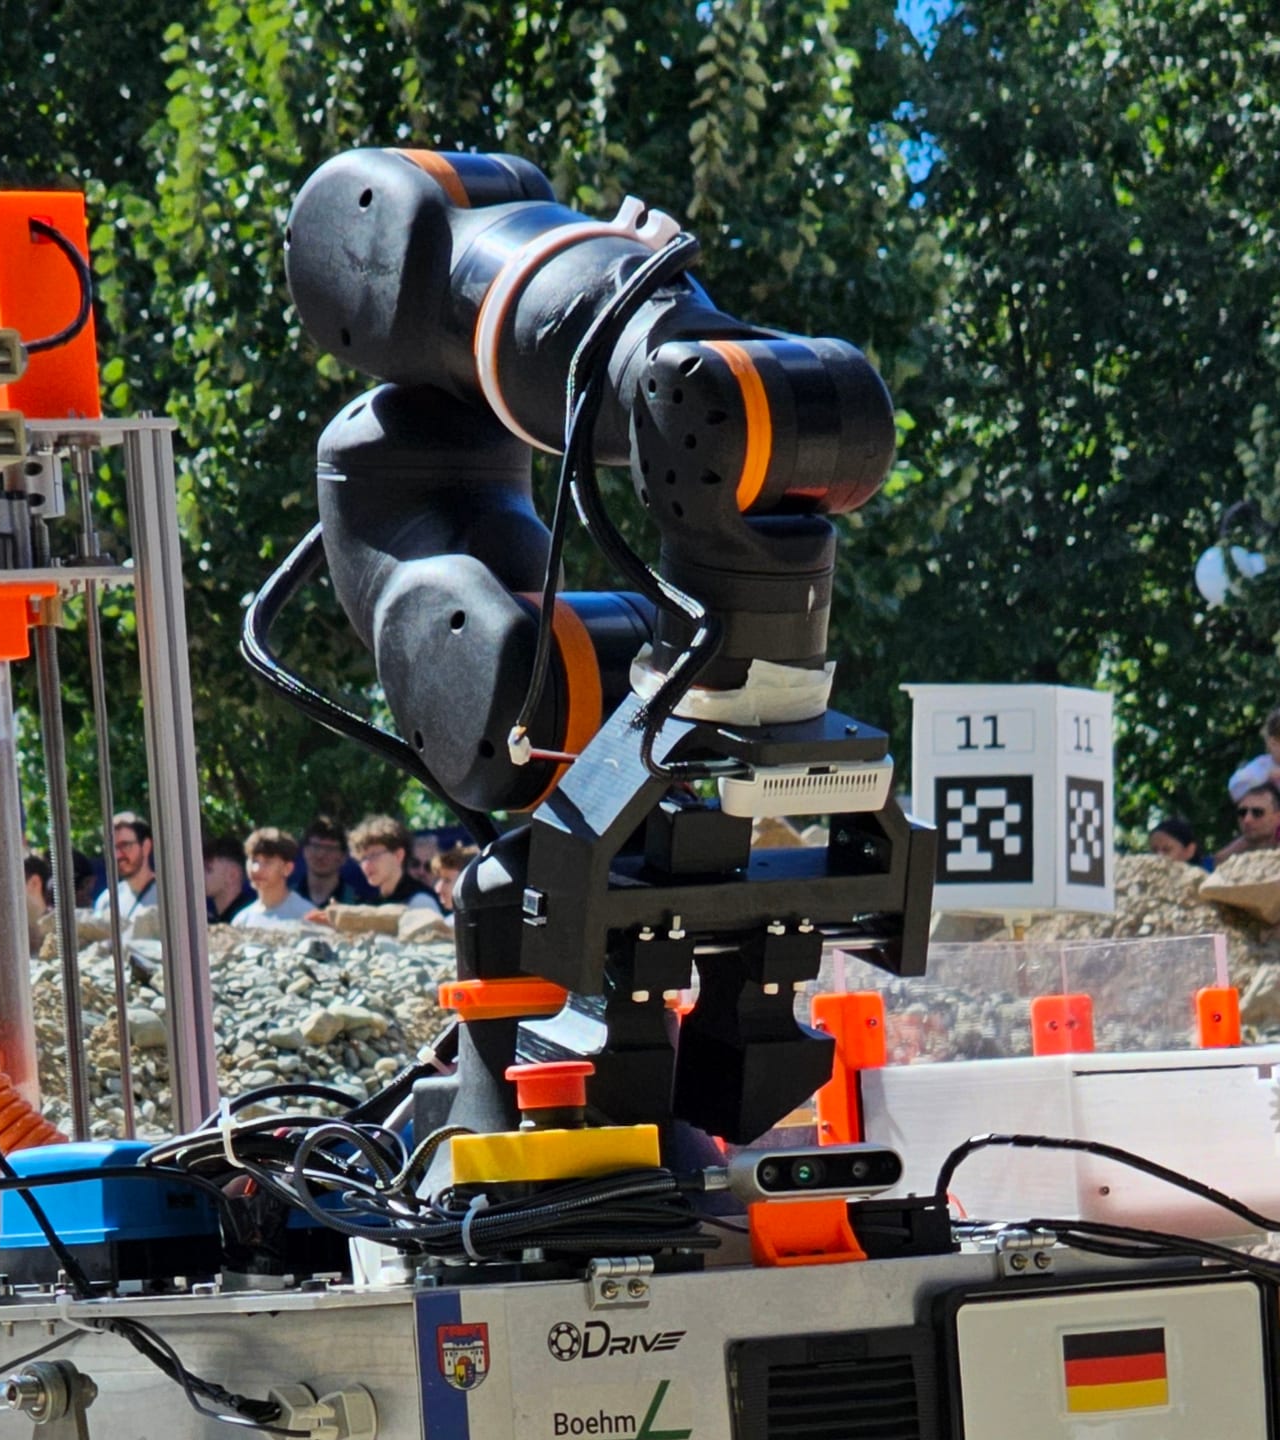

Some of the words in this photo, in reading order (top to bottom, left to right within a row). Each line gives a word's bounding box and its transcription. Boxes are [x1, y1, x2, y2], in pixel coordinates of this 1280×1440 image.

[955, 714, 1006, 751] 11
[1073, 716, 1094, 753] 11
[553, 1409, 637, 1436] Boehm
